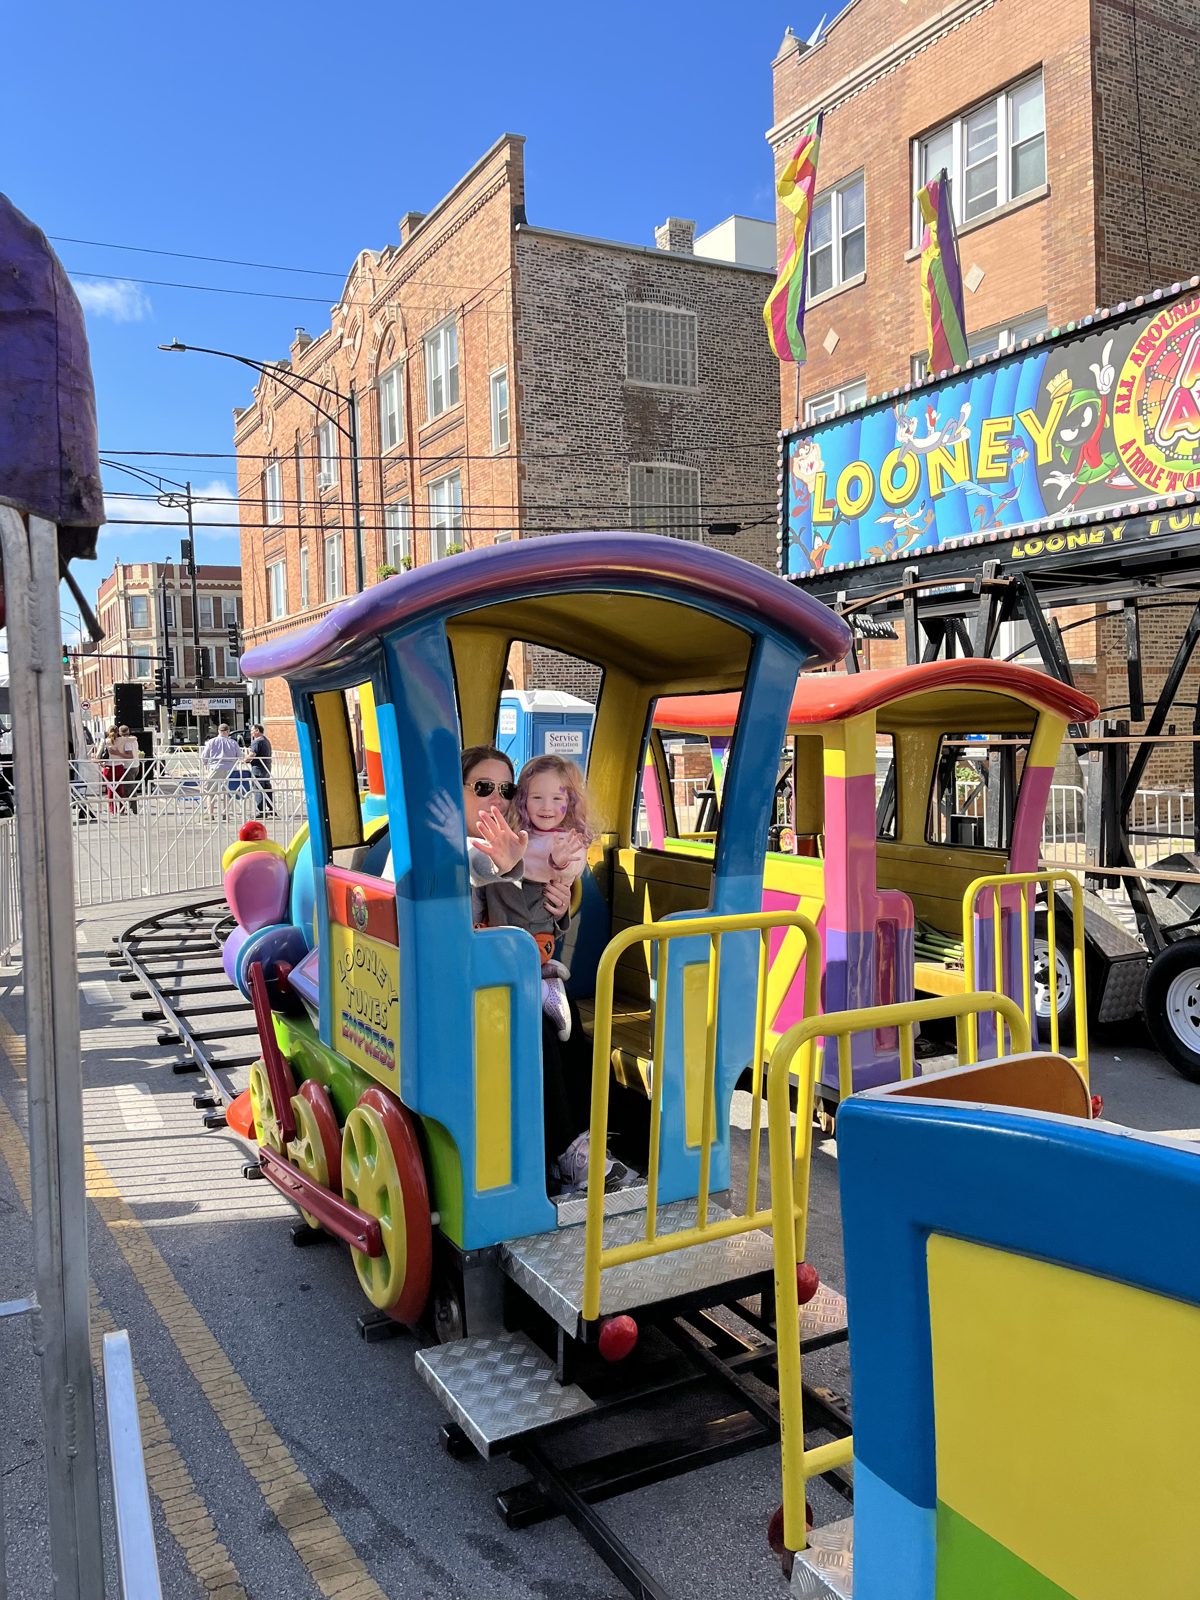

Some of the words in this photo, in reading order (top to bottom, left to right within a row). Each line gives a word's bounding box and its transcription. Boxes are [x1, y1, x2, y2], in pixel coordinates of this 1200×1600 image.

[1115, 375, 1137, 415] ALL
[812, 394, 1068, 527] LOONEY
[1119, 438, 1137, 456] A
[1126, 446, 1166, 489] TRIPLE
[1011, 521, 1129, 559] LOONEY
[550, 732, 579, 742] Service
[337, 943, 399, 1007] LOONEY
[345, 980, 389, 1031] TUNES
